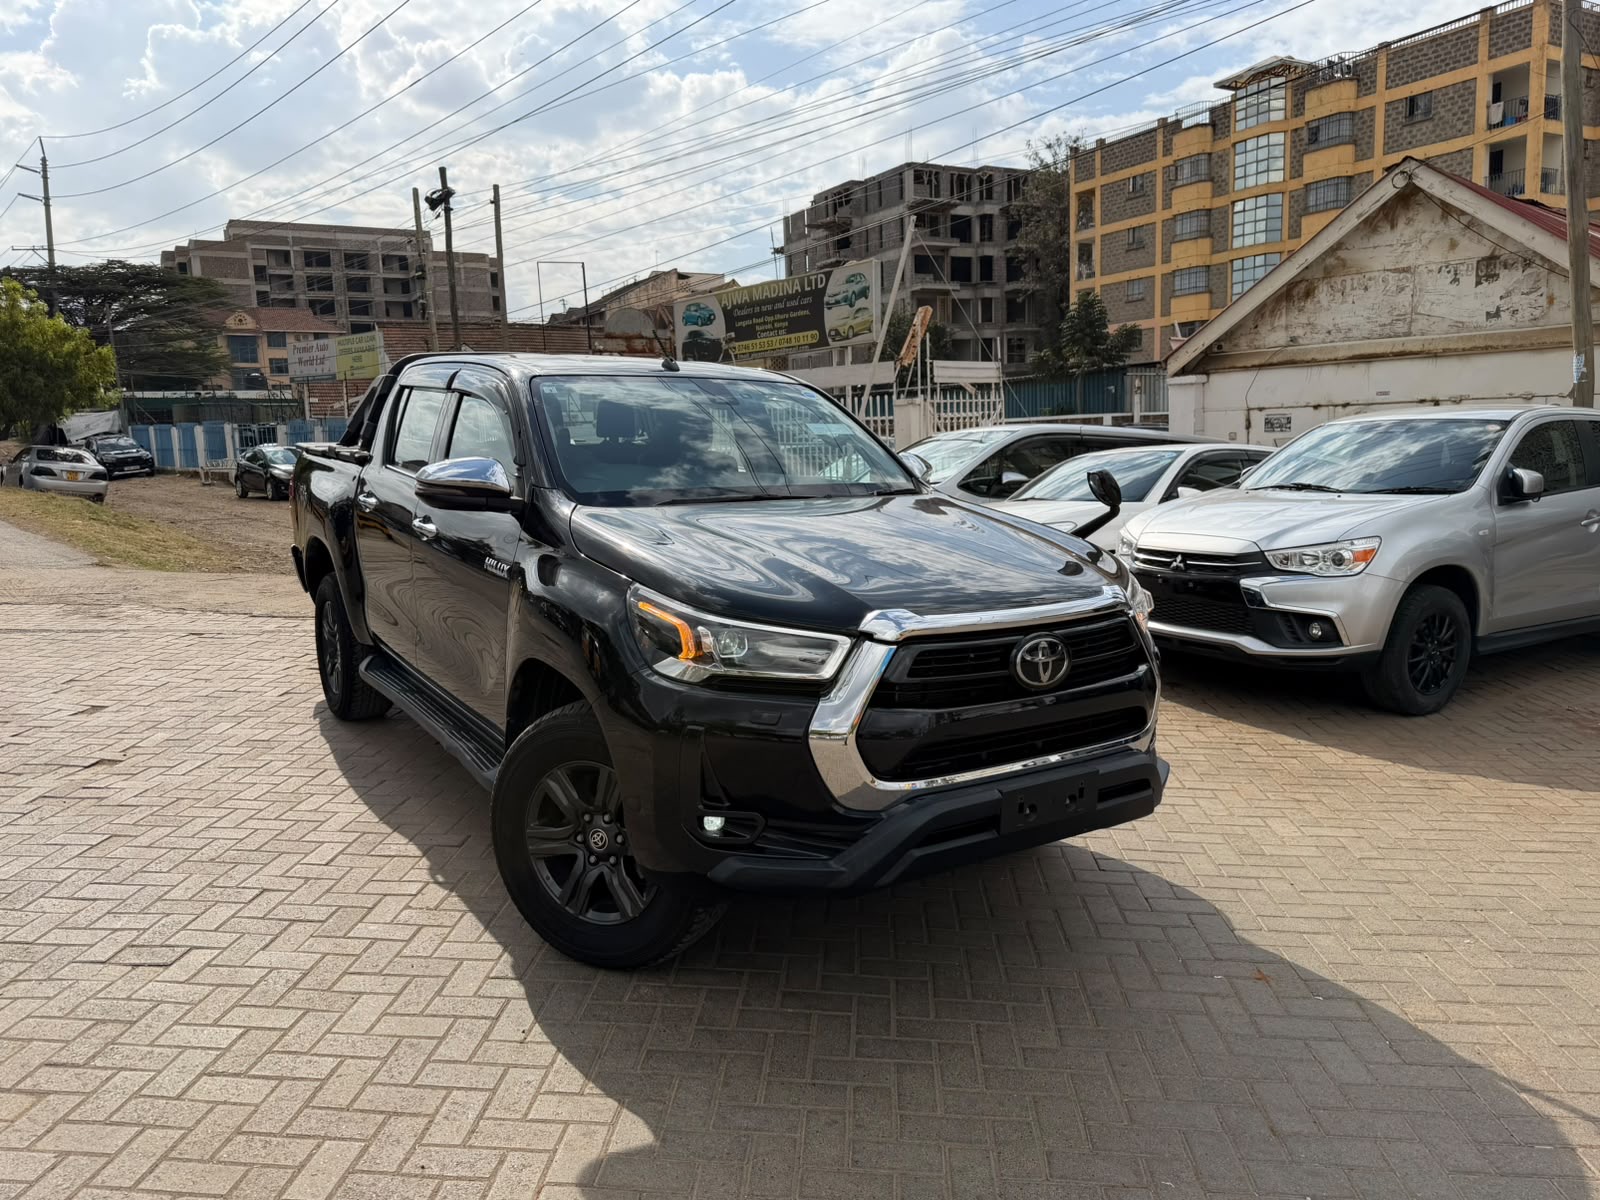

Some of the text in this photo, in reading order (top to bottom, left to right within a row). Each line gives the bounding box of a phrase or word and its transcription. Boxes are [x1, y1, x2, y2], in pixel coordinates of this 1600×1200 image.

[721, 273, 826, 309] AJWA MADINA LTD
[733, 295, 812, 317] Dealers in new and used cars
[757, 328, 787, 339] Contact us:
[293, 341, 329, 355] Premier Auto
[737, 343, 750, 352] 0746
[751, 342, 758, 350] 51
[759, 341, 766, 349] 53
[767, 340, 774, 348] 53
[779, 337, 792, 346] 0748
[794, 336, 800, 344] 10
[810, 333, 818, 341] 90
[298, 354, 326, 367] World Ltd
